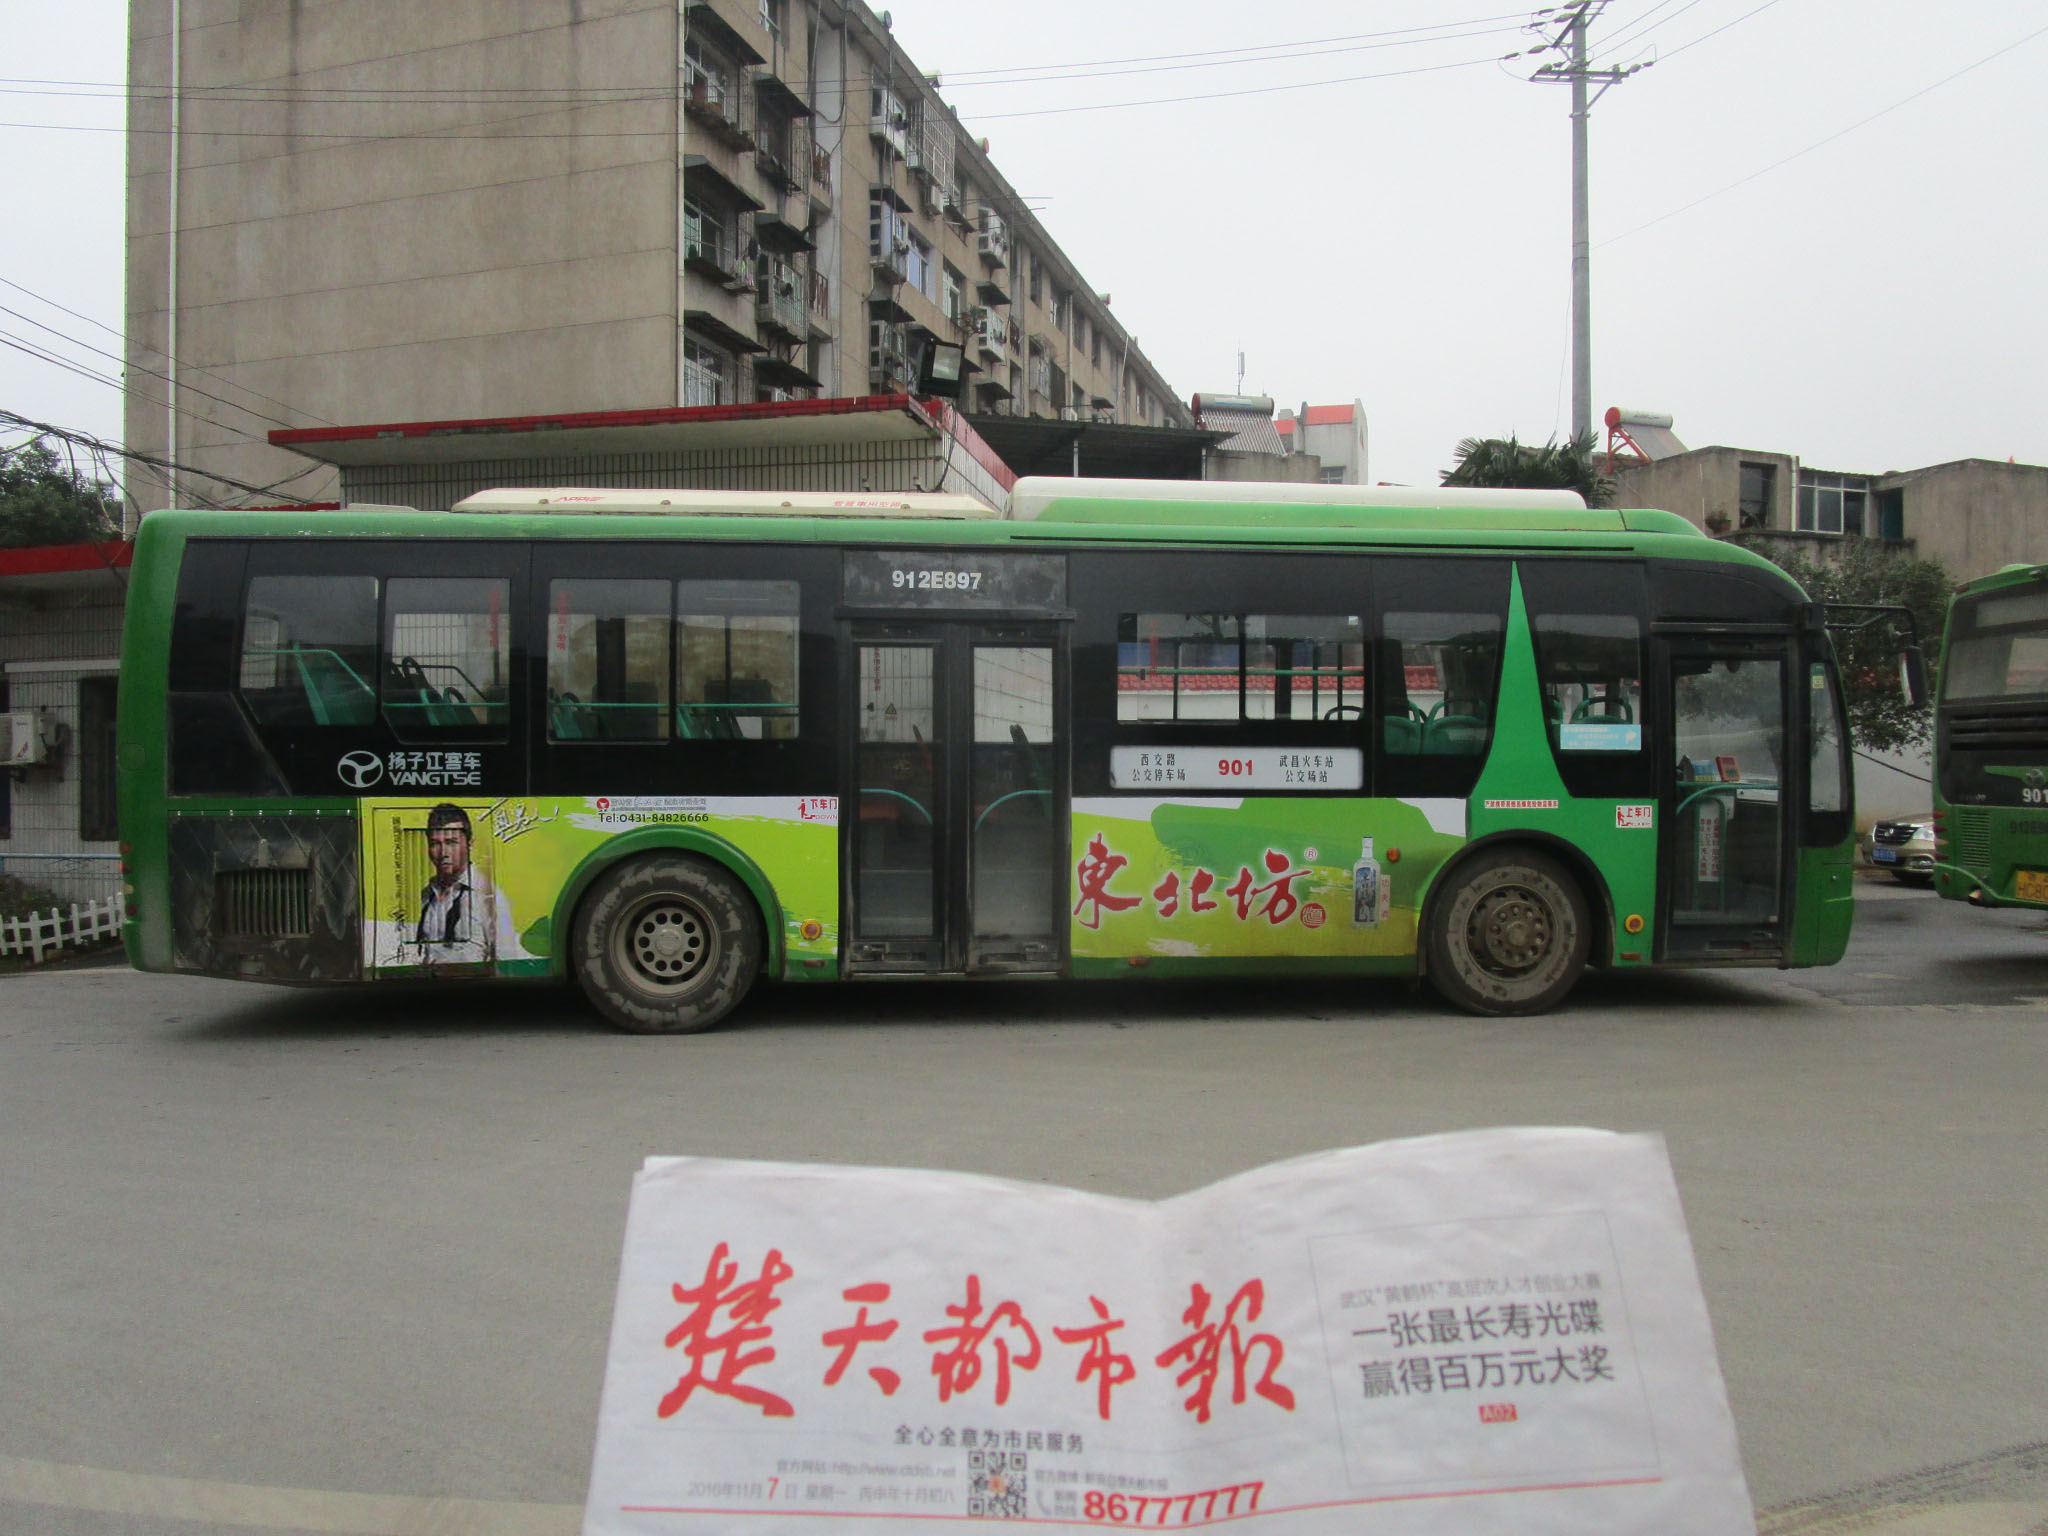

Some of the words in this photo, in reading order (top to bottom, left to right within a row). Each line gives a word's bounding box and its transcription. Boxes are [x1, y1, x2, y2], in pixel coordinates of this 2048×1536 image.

[892, 570, 982, 590] 912E897
[388, 752, 482, 770] 扬子江客车
[1140, 753, 1176, 767] 西交路
[1218, 759, 1254, 776] 901
[1279, 754, 1335, 768] 武昌火车站
[388, 771, 482, 786] YANGTSE
[1132, 768, 1187, 782] 公交停车场
[1285, 769, 1329, 783] 公交场站
[810, 798, 838, 810] 下车门
[1626, 806, 1651, 818] 上车门
[598, 812, 709, 823] Tel:0431-84826666
[1352, 1298, 1605, 1349] 一张最长寿光碟
[1358, 1345, 1616, 1398] 赢得百万元大奖
[894, 1424, 1085, 1454] 全心全意为市民服务
[1083, 1481, 1265, 1526] 86777777
